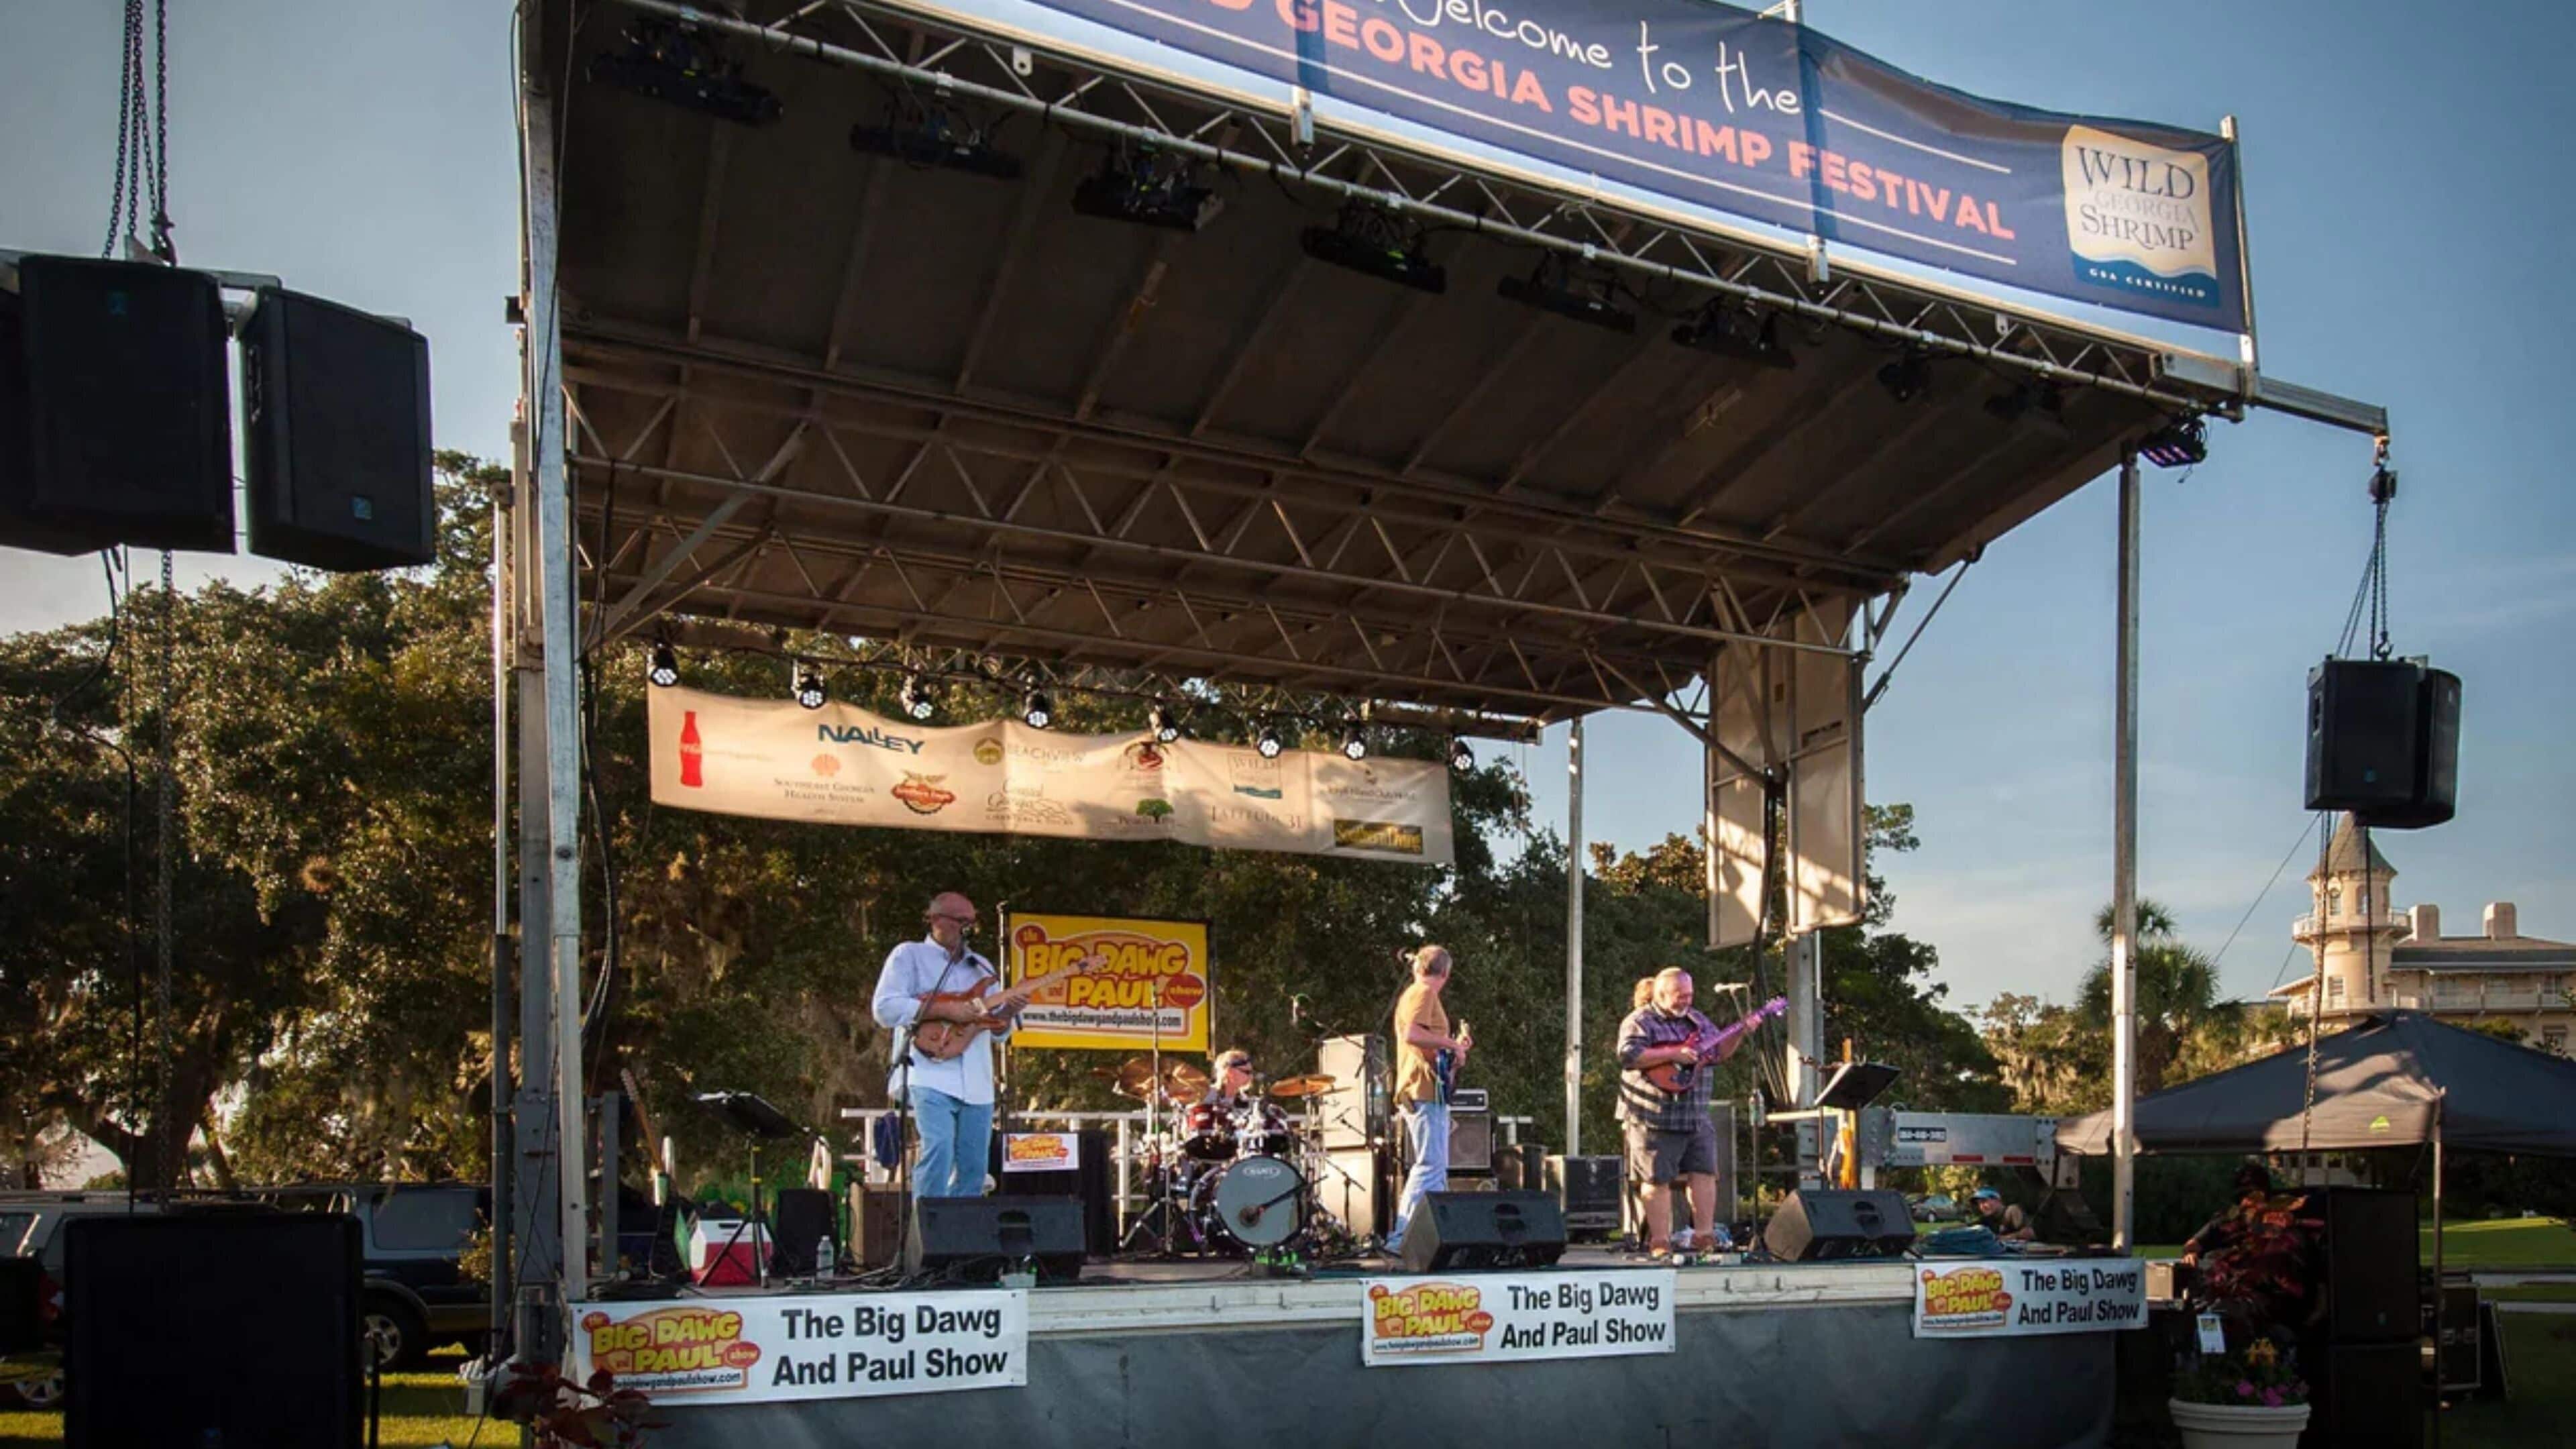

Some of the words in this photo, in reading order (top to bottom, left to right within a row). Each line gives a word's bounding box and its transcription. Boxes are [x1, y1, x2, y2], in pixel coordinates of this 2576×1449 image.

[1636, 20, 1692, 94] to
[1715, 40, 1802, 115] the
[1276, 0, 1554, 113] GEORGIA
[1569, 85, 1772, 168] SHRIMP
[1788, 145, 2015, 240] FESTIVAL
[2076, 145, 2194, 200] WILD
[2080, 203, 2194, 251] SHRIMP
[2094, 189, 2201, 233] GEORGIA
[1026, 943, 1086, 977] BIG
[1068, 976, 1164, 1008] PAUL
[1507, 1284, 1552, 1311] The
[1558, 1283, 1593, 1314] Big
[1599, 1281, 1659, 1310] Dawg
[1926, 1279, 1956, 1299] BIG
[1960, 1272, 2003, 1293] DAWG
[2021, 1269, 2056, 1291] The
[2061, 1269, 2089, 1295] Big
[2094, 1269, 2138, 1292] Dawg
[1377, 1295, 1414, 1320] BIG
[1419, 1288, 1479, 1313] DAWG
[1947, 1294, 1992, 1313] PAUL
[2018, 1301, 2051, 1325] And
[2056, 1299, 2092, 1323] Paul
[2096, 1299, 2141, 1321] Show
[593, 1324, 649, 1355] BIG
[656, 1313, 741, 1344] DAWG
[781, 1307, 847, 1340] The
[854, 1305, 906, 1344] Big
[916, 1304, 1002, 1340] Dawg
[1405, 1313, 1466, 1337] PAUL
[1500, 1324, 1546, 1349] And
[1552, 1321, 1599, 1346] Paul
[1605, 1318, 1666, 1343] Show
[635, 1344, 722, 1371] PAUL
[772, 1351, 837, 1388] And
[847, 1348, 915, 1384] Paul
[924, 1347, 1009, 1379] Show
